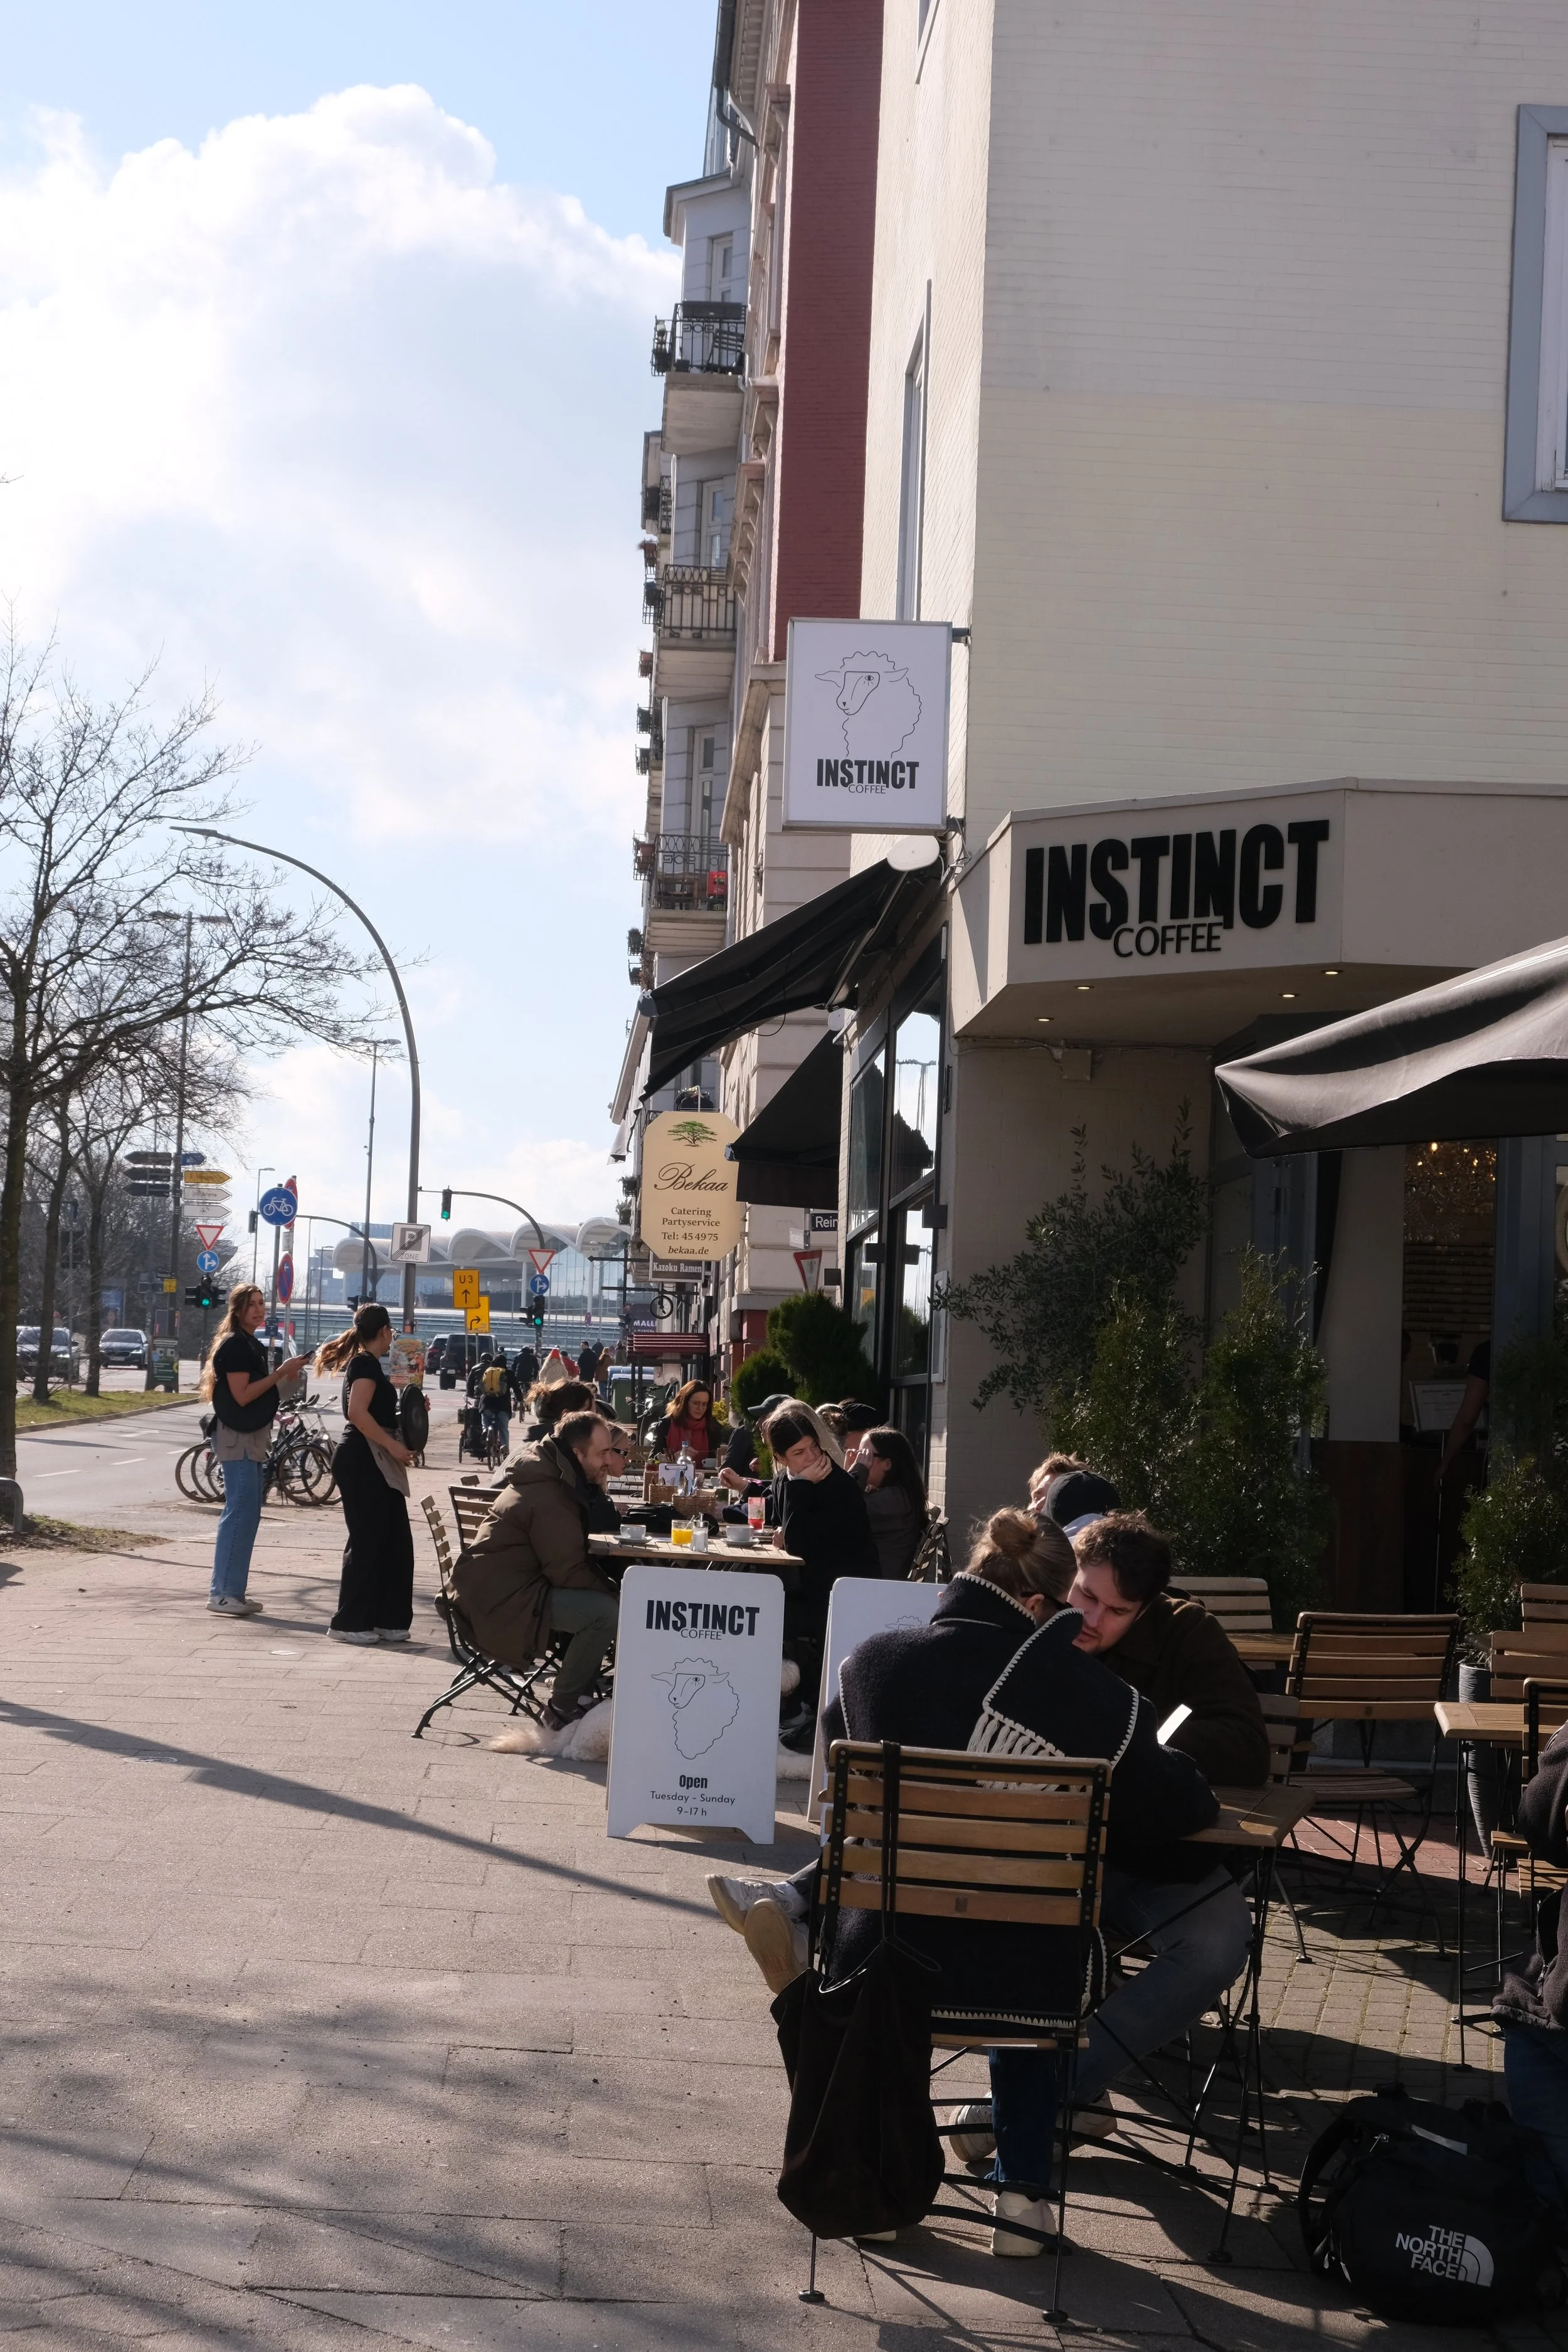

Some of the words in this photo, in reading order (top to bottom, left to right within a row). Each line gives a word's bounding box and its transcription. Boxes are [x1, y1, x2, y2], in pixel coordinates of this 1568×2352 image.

[816, 758, 920, 789] INSTINCT
[848, 783, 886, 795] COFFEE
[1024, 819, 1330, 945] INSTINCT
[1113, 921, 1224, 958] COFFEE
[654, 1162, 729, 1192] Bekaa
[670, 1206, 712, 1217] Catering
[662, 1217, 721, 1228] Partyservice
[661, 1232, 679, 1240] Tel:
[667, 1246, 709, 1255] bekaa.de
[653, 1262, 678, 1272] Kazoku
[679, 1263, 702, 1273] Ramen
[645, 1599, 760, 1636] INSTINCT
[680, 1628, 723, 1641] COFFEE
[679, 1774, 708, 1789] Open
[650, 1791, 689, 1803] Tuesday
[700, 1794, 736, 1806] Sunday
[1429, 2225, 1465, 2249] THE
[1395, 2232, 1462, 2265] NORTH
[1411, 2254, 1459, 2280] FACE
